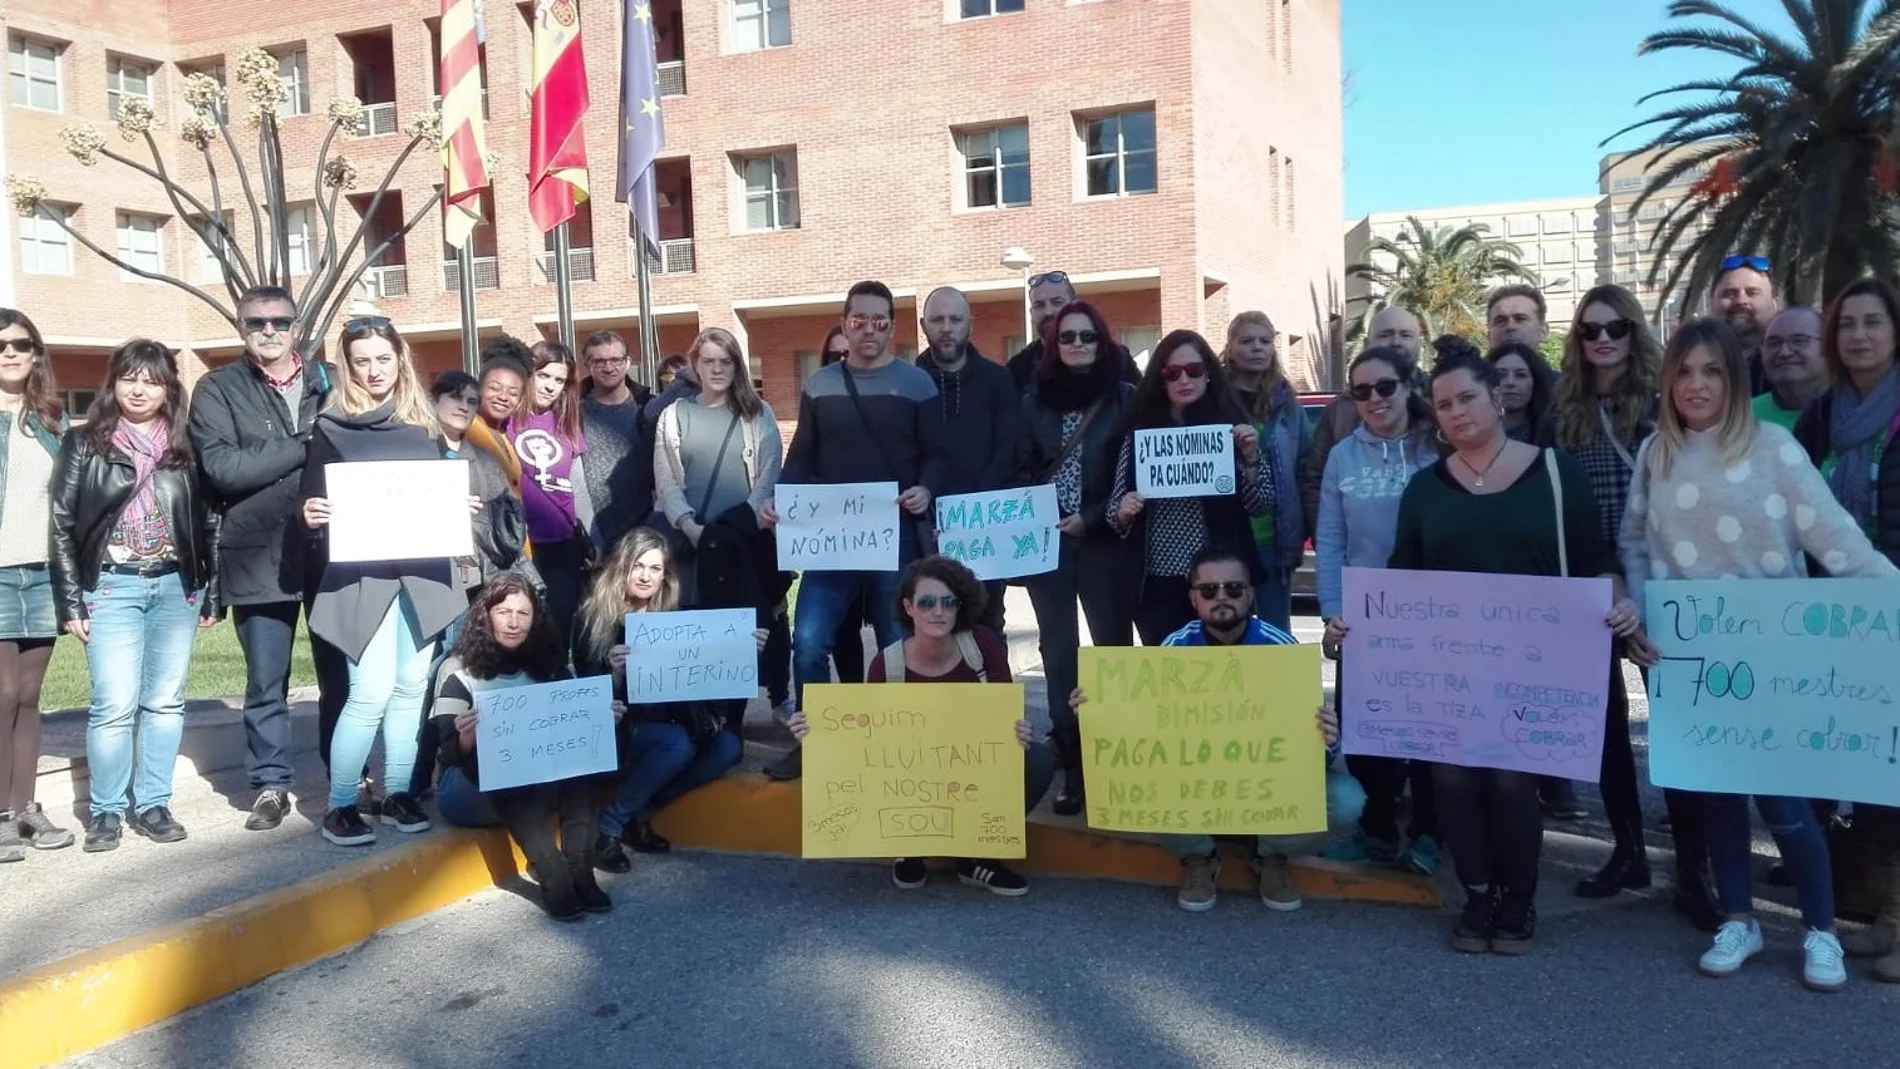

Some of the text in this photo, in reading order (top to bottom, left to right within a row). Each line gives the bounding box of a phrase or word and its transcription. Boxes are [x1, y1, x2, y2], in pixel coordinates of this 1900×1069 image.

[1140, 428, 1224, 463] ¿Y LAS NÓMINAS
[1150, 458, 1215, 487] PA CUÁNDO?
[943, 527, 1050, 562] PAGA YA!
[1365, 591, 1460, 620] Nuestra
[633, 623, 736, 645] ADOPTA A
[1781, 601, 1900, 643] COBRA
[678, 646, 700, 660] UN
[1431, 638, 1504, 656] frente
[1524, 644, 1543, 663] a
[1372, 671, 1471, 693] VUESTRA
[1770, 666, 1894, 704] mestres
[486, 694, 527, 715] 700
[1365, 698, 1392, 713] es
[1407, 694, 1422, 714] la
[528, 709, 590, 731] COBRAR
[822, 707, 926, 738] Seguim
[1683, 721, 1782, 750] sense
[500, 749, 512, 762] 3
[864, 742, 1005, 771] LLUITANT
[1094, 737, 1287, 768] PAGA LO QUE
[826, 774, 862, 800] pel
[1108, 778, 1274, 804] NOS DEBES
[891, 814, 946, 832] SOU
[980, 825, 1010, 834] 700
[1096, 807, 1109, 826] 3
[1119, 809, 1189, 828] MESES
